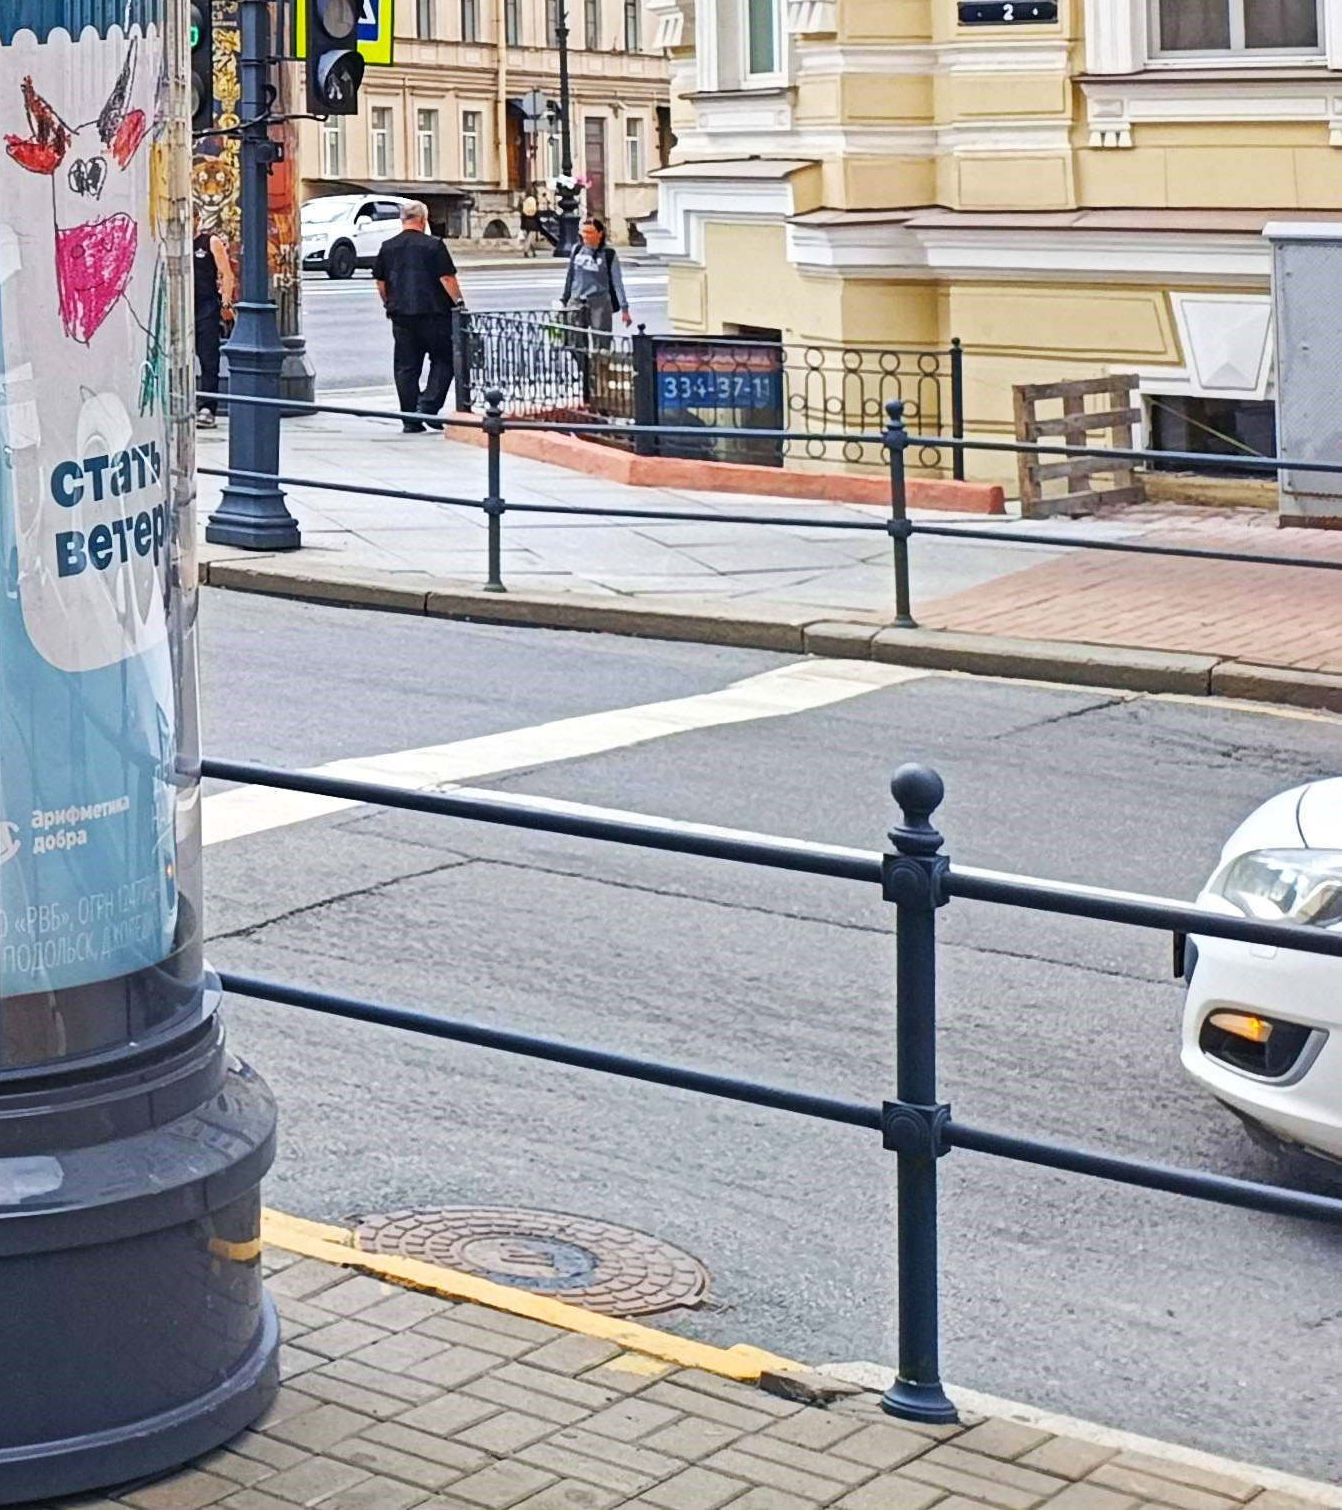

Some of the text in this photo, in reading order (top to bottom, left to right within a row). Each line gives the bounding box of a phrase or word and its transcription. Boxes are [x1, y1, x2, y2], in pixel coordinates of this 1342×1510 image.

[1002, 3, 1014, 21] 2
[50, 440, 161, 508] стать
[32, 828, 89, 855] добра
